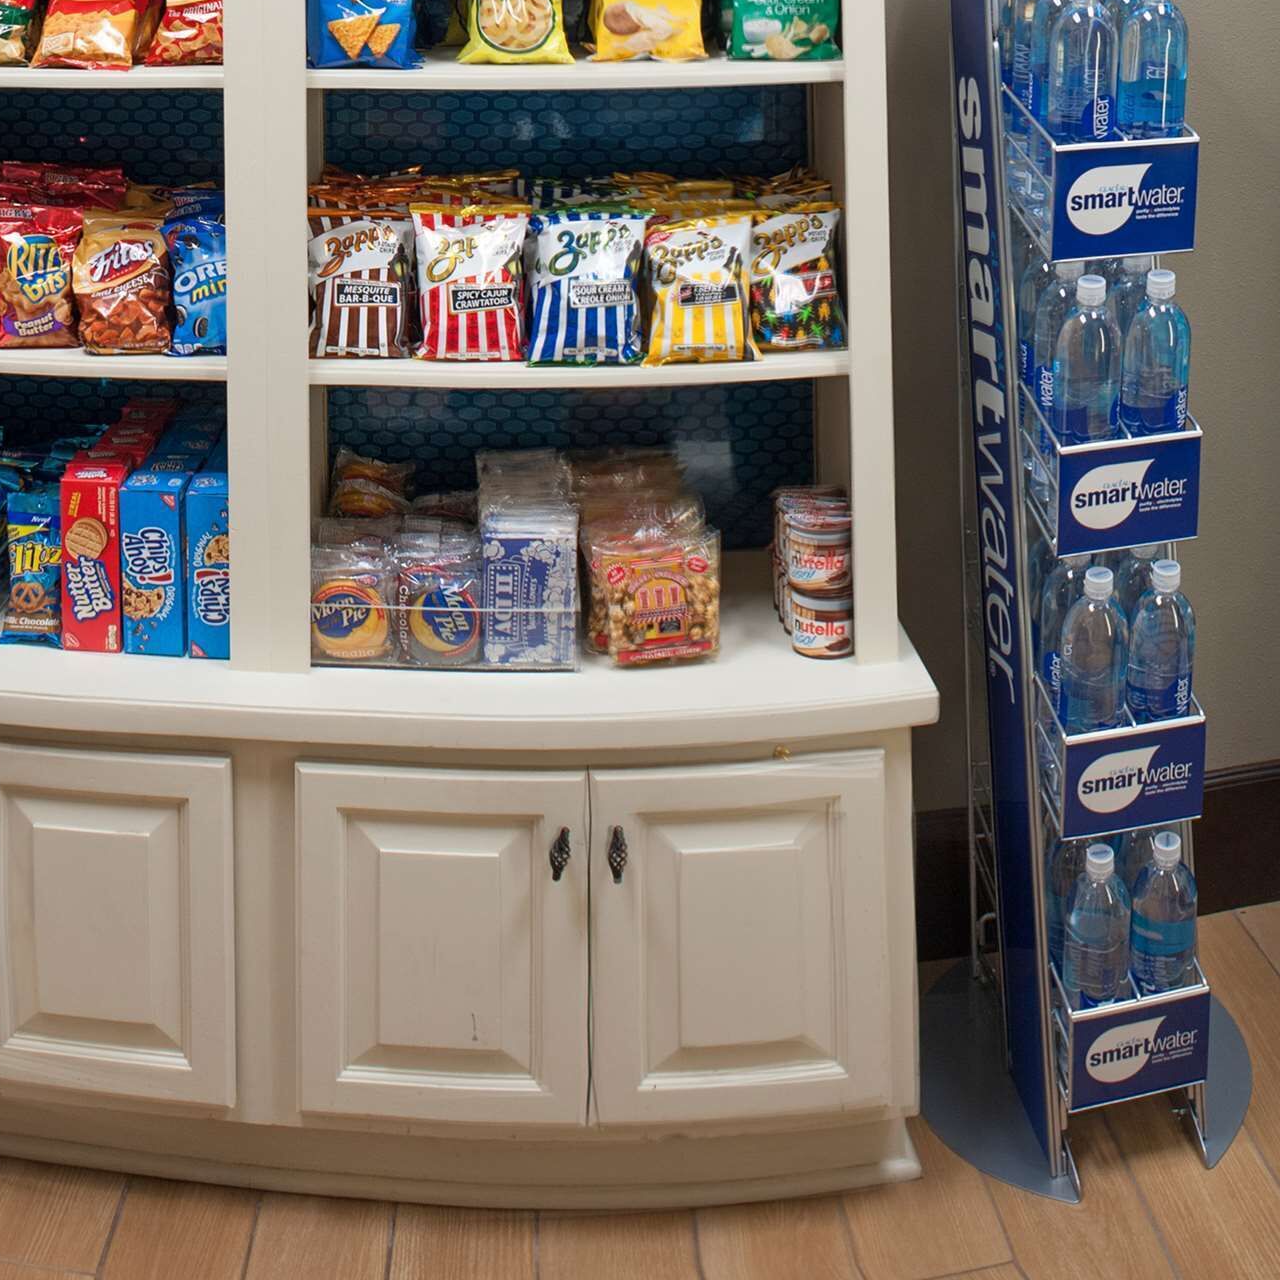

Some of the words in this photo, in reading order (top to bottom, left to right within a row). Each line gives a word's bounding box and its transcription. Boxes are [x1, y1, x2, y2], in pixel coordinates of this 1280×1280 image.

[773, 4, 811, 16] Onion
[1094, 97, 1110, 140] water
[1070, 184, 1184, 212] smartwater
[89, 239, 153, 283] Fritos
[22, 271, 67, 301] bits
[339, 294, 394, 304] BAR-B-QUE
[343, 285, 391, 295] MESQUITE
[457, 290, 480, 300] SPICY
[480, 289, 509, 299] CAJUN
[575, 285, 598, 296] SOUR
[599, 284, 622, 295] CREAM
[606, 293, 631, 305] ONION
[454, 296, 511, 311] CRAWTATORS
[14, 312, 54, 329] Peanut
[18, 320, 54, 336] Butter
[958, 76, 1016, 704] smartwater
[1074, 477, 1187, 510] smartwater
[123, 534, 173, 585] Ahoy!
[140, 527, 169, 575] Chips
[193, 532, 212, 568] ORIGINAL
[791, 549, 845, 571] nutella
[65, 561, 95, 620] Nutter
[80, 556, 114, 614] Butter
[159, 586, 176, 621] ORIGINAL
[199, 577, 222, 624] Chips
[441, 582, 470, 632] Moon
[342, 607, 368, 627] Pie
[434, 614, 457, 642] Pie
[794, 618, 846, 636] nutella
[1081, 761, 1193, 797] smartwater
[1089, 1028, 1199, 1068] smartwater
